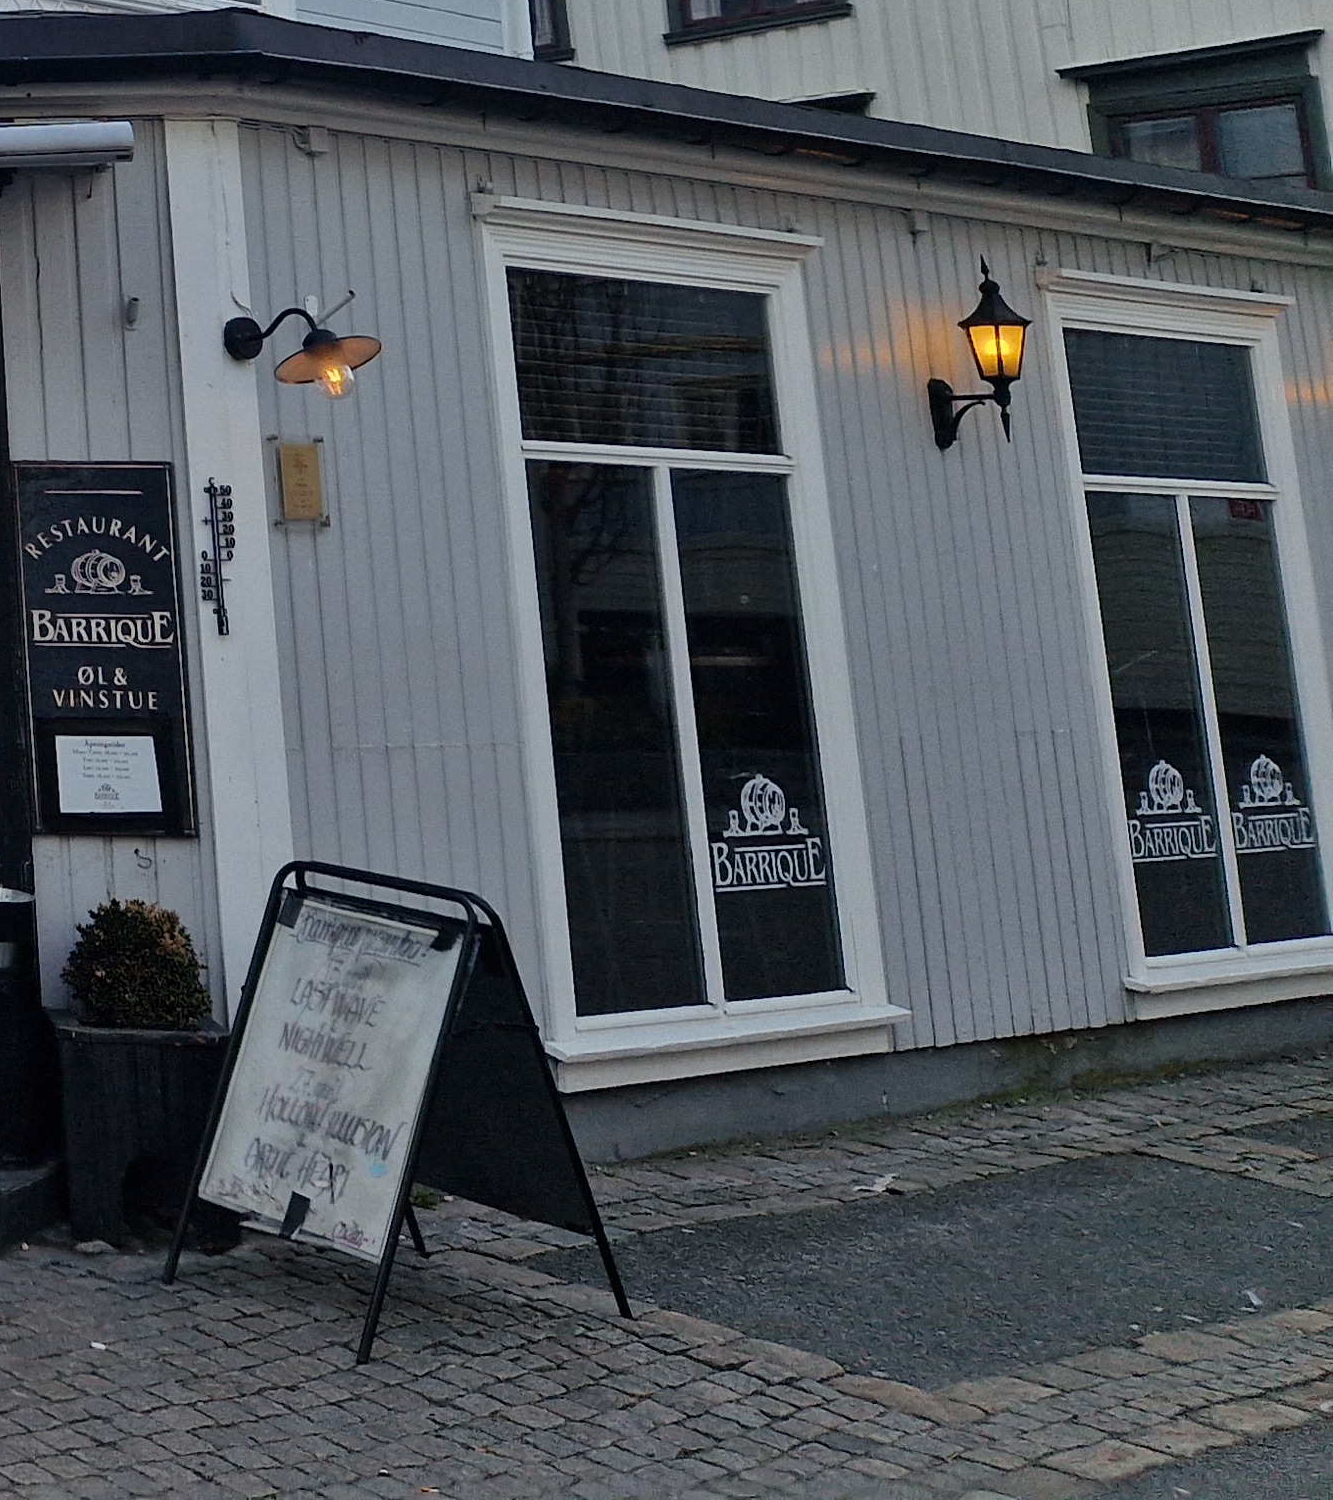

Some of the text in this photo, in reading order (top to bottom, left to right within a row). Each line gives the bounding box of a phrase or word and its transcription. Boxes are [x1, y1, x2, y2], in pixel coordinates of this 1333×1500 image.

[219, 485, 231, 494] 50
[221, 499, 232, 508] 40
[222, 512, 233, 521] 30
[223, 525, 234, 534] 20
[24, 516, 170, 563] RESTAURANT
[225, 538, 235, 547] 10
[200, 564, 211, 573] 10
[200, 577, 212, 586] 20
[201, 590, 213, 599] 30
[31, 609, 175, 646] BARRIQUE
[77, 666, 128, 686] ØL &
[52, 689, 158, 710] VINSTUE
[1232, 807, 1316, 851] BARRIQUE
[1128, 815, 1217, 858] BARRIQUE
[711, 837, 826, 886] BARRIQUE
